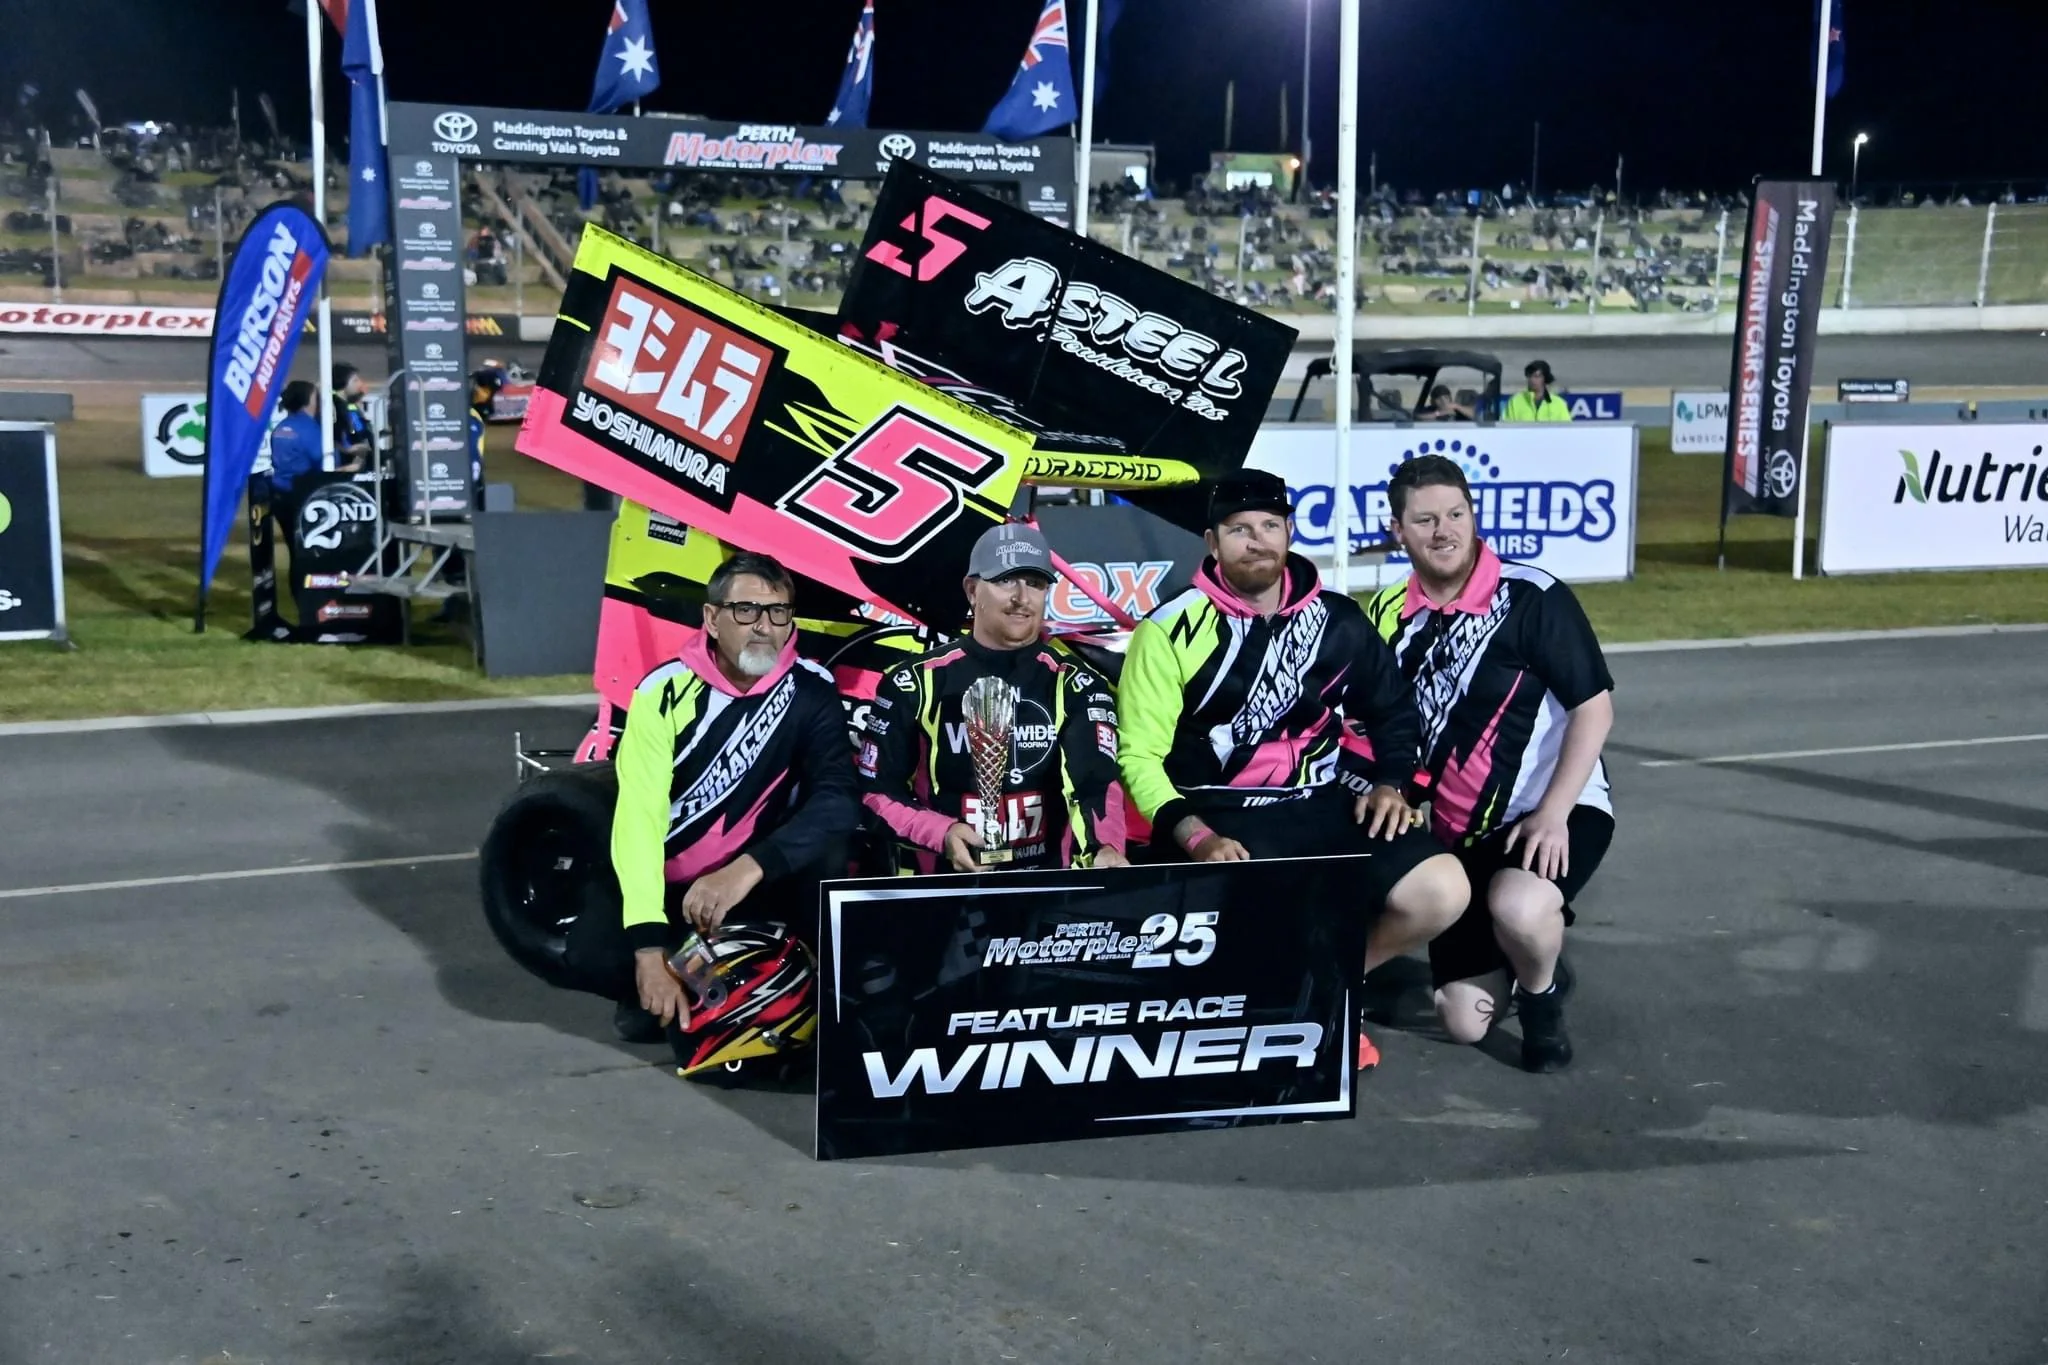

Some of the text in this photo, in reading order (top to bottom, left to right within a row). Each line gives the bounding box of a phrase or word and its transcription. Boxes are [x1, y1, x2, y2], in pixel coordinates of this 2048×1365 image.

[493, 121, 628, 141] Maddington Toyota &
[737, 125, 796, 142] PERTH
[432, 141, 481, 155] TOYOTA
[493, 137, 620, 157] Canning Vale Toyota
[663, 132, 843, 170] Motorplex
[928, 142, 1041, 159] Maddington Toyota &
[928, 157, 1034, 173] Canning Vale Toyota
[865, 195, 992, 281] 5
[0, 308, 210, 330] otorplex
[223, 221, 297, 404] BURSON
[1771, 200, 1818, 431] Maddington Toyota
[256, 278, 302, 392] AUTO PARTS
[1737, 241, 1773, 457] SPRINTCAR SERIES
[1571, 397, 1614, 418] AL
[572, 391, 729, 494] YOSHIMURA
[1675, 435, 1725, 444] LANDSCA
[776, 401, 1009, 564] 5
[304, 500, 378, 549] 2ND
[2005, 514, 2048, 543] Wa
[1014, 725, 1058, 741] WIDE
[1018, 741, 1049, 749] ROOFING
[1010, 768, 1023, 784] S
[983, 911, 1219, 969] Motorplex 25
[1055, 921, 1113, 938] PERTH
[947, 995, 1247, 1036] FEATURE RACE
[862, 1022, 1324, 1098] WINNER
